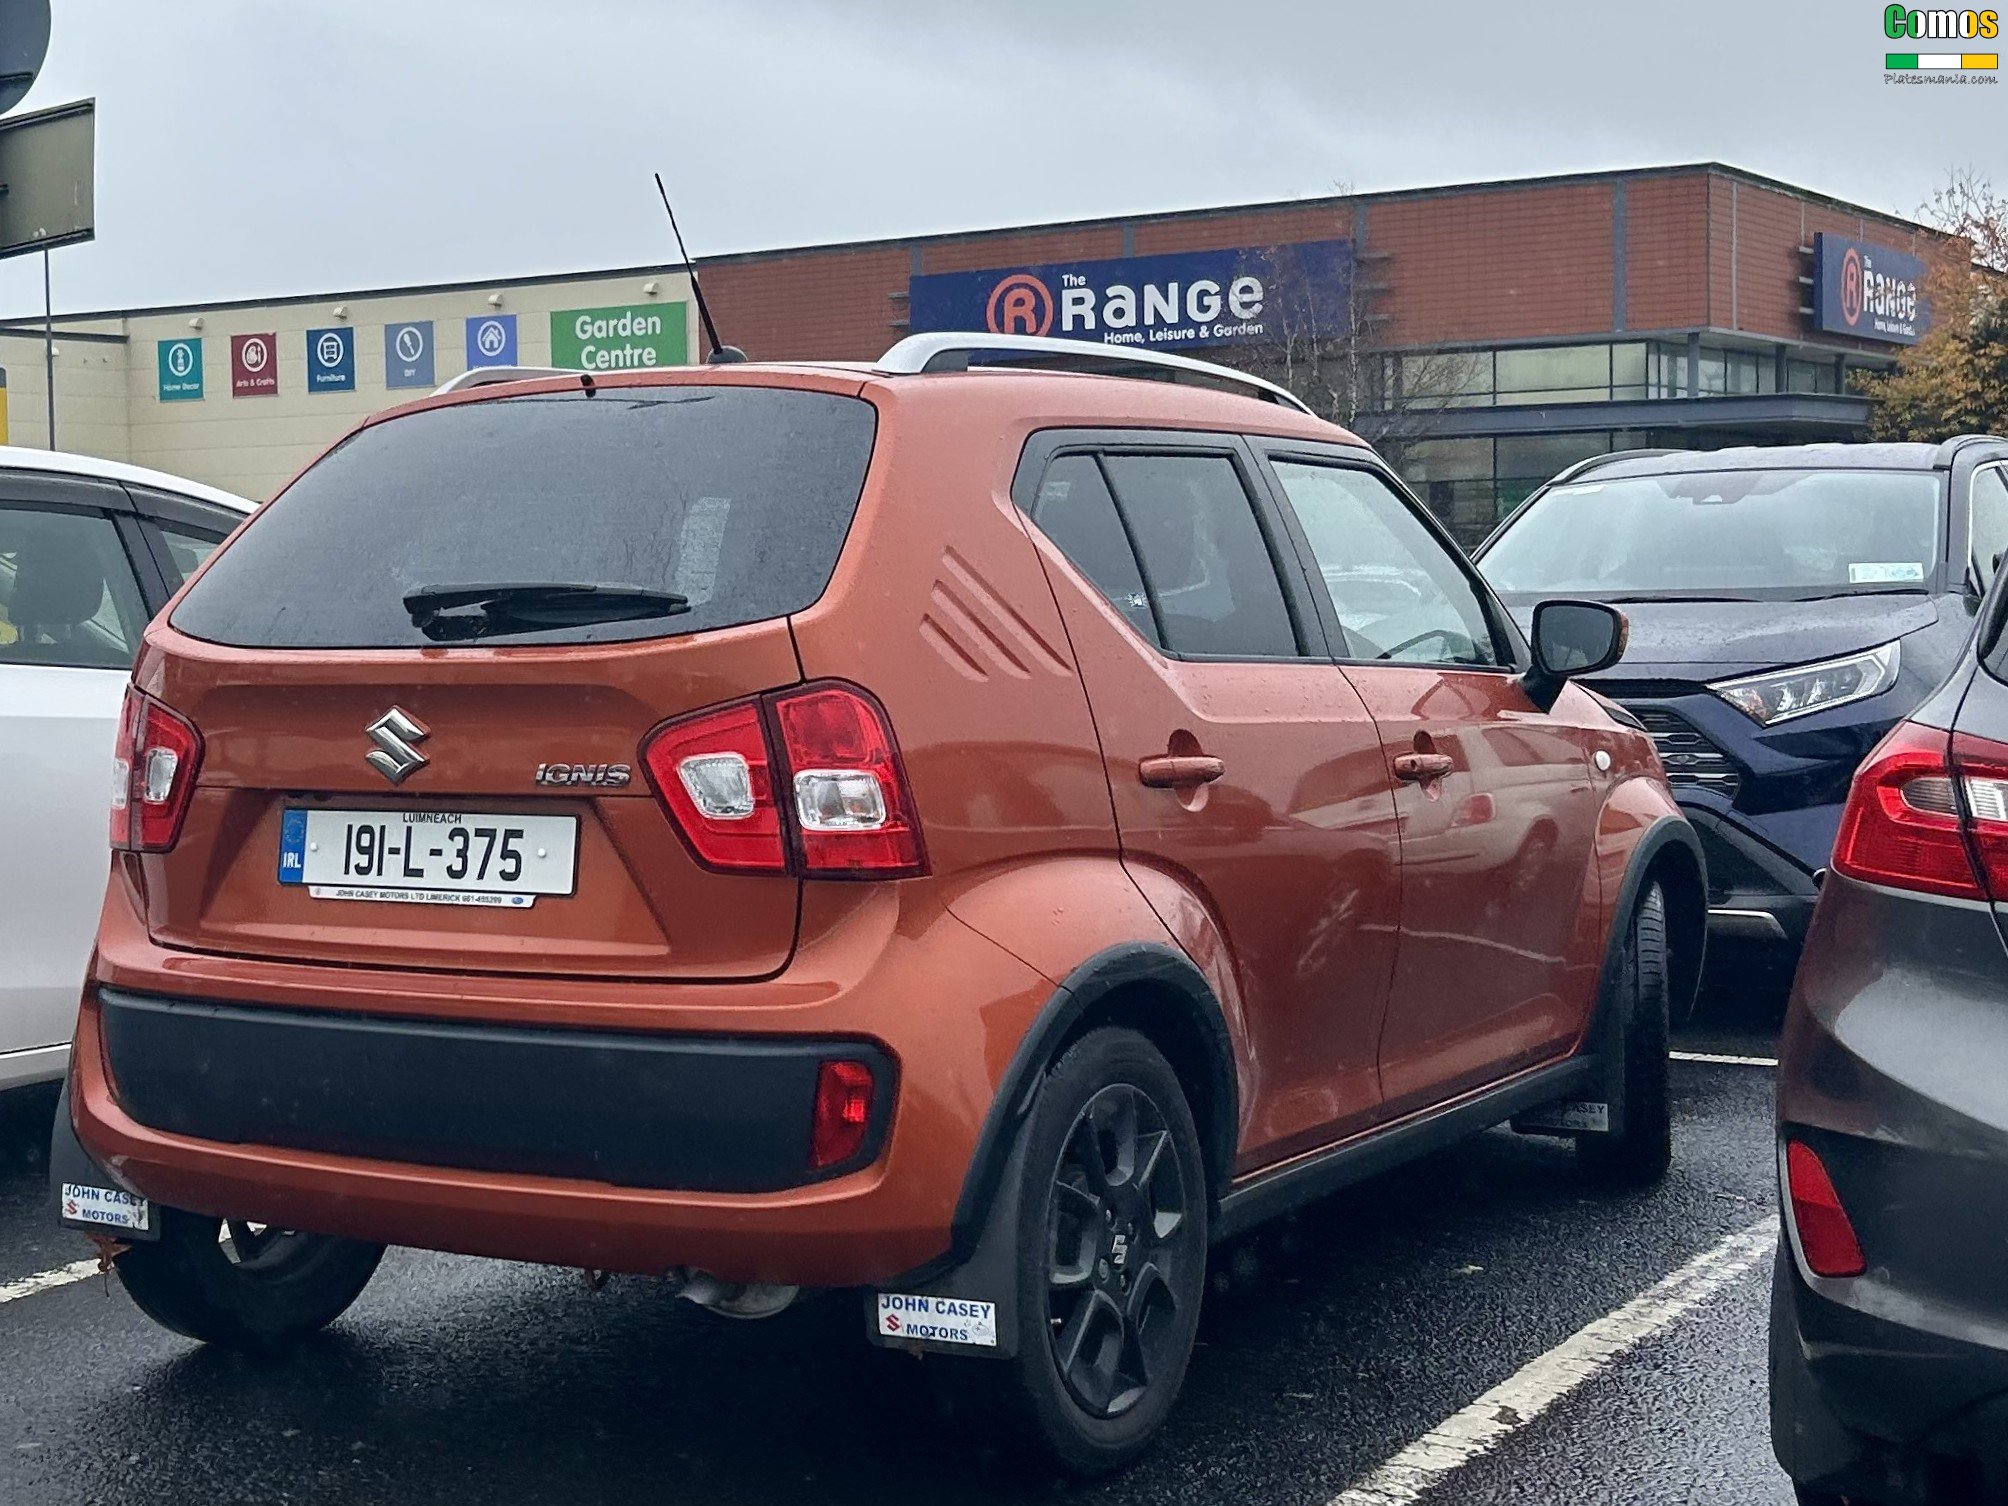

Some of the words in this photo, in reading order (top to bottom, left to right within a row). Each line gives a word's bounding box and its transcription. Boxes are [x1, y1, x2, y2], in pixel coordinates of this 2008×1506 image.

[1062, 274, 1086, 287] The
[575, 311, 661, 340] Garden
[1104, 332, 1145, 344] Home,
[1149, 328, 1196, 341] Leisure
[1200, 325, 1210, 338] &
[1213, 322, 1264, 337] Garden
[581, 343, 656, 370] Centre
[236, 380, 249, 388] Arts
[250, 378, 255, 387] &
[256, 377, 275, 386] Crafts
[316, 374, 346, 383] Furniture
[536, 763, 631, 787] IGNIS
[402, 813, 462, 824] LUIMNEACH
[283, 852, 301, 868] IRL
[344, 824, 524, 881] 191-L-375
[379, 892, 409, 900] MOTORS
[65, 1184, 100, 1201] JOHN
[82, 1209, 129, 1224] MOTORS
[881, 1296, 929, 1313] JOHN
[935, 1301, 991, 1319] CASEY
[906, 1323, 968, 1341] MOTORS
